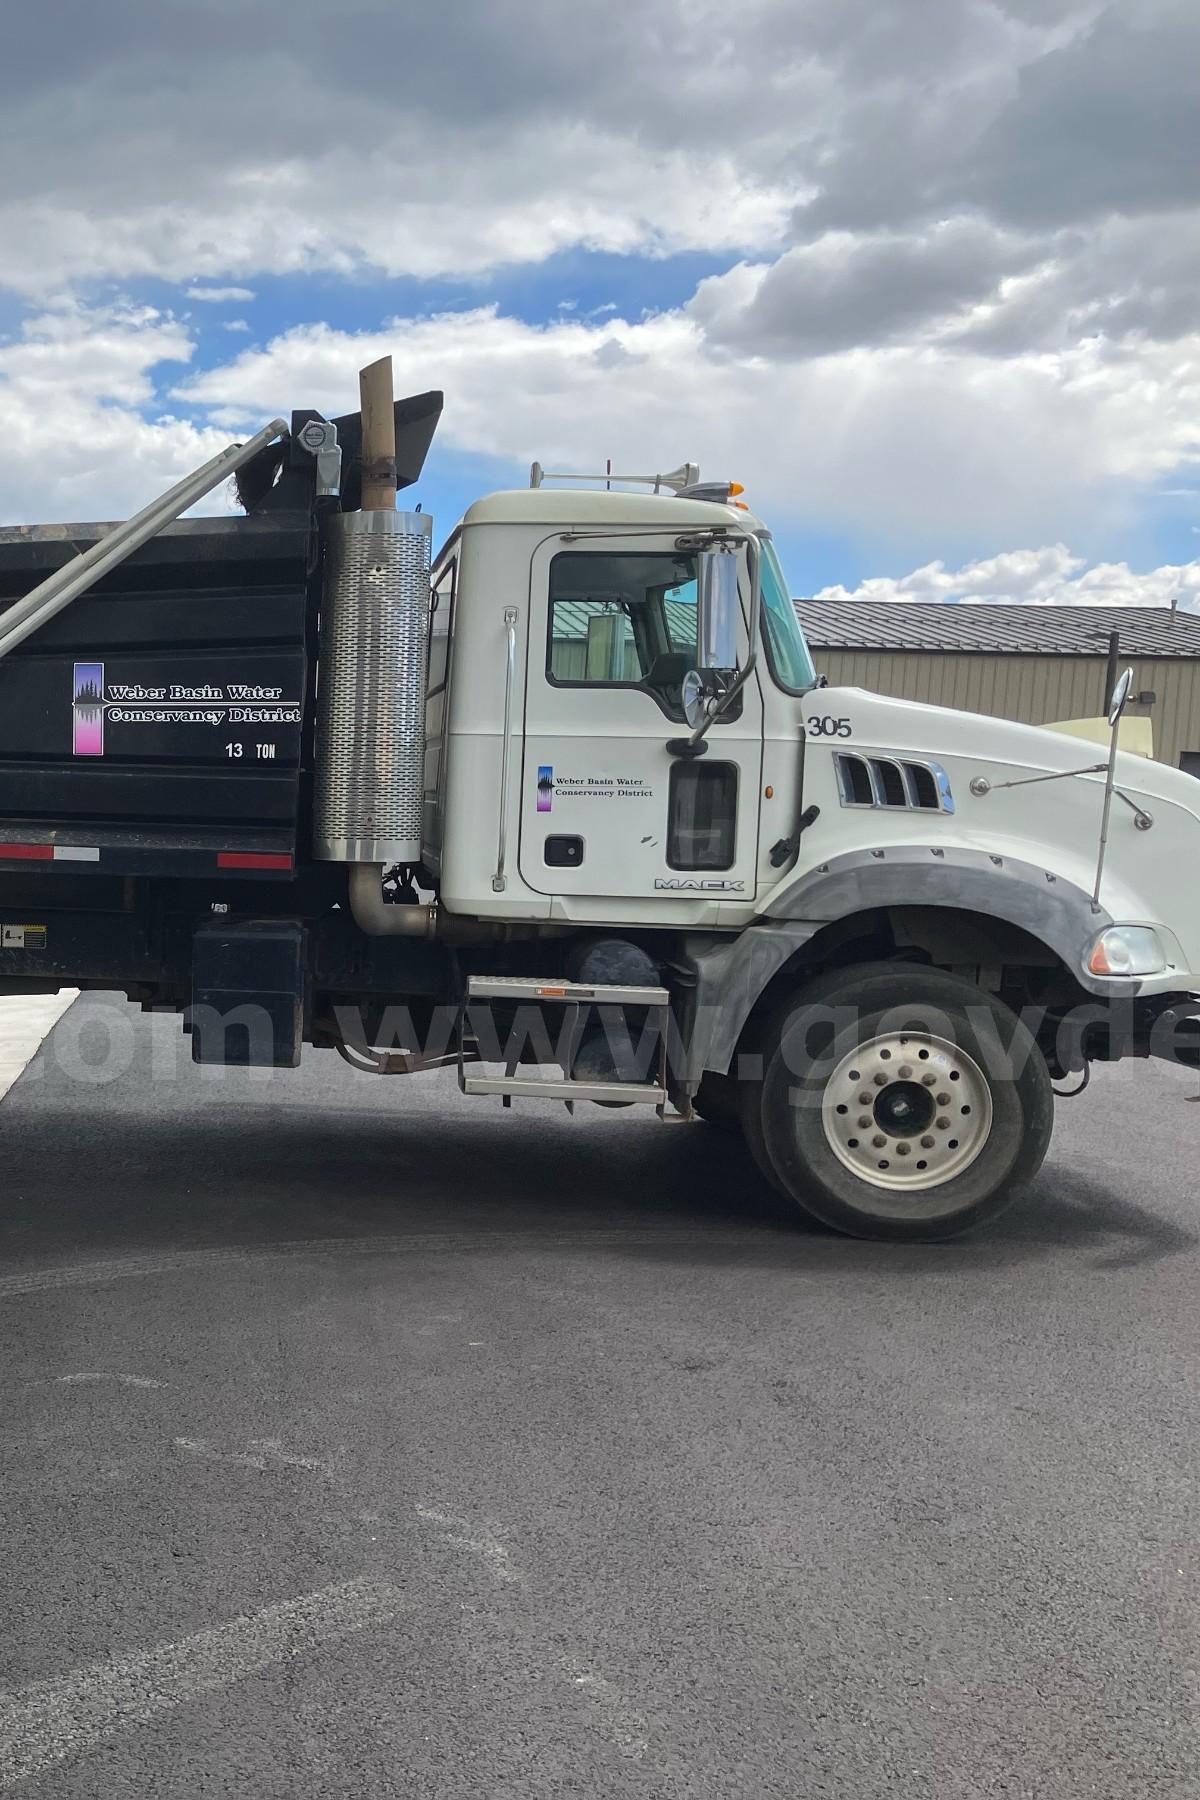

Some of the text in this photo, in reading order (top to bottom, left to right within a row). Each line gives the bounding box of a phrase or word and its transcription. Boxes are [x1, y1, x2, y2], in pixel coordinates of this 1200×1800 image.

[108, 685, 283, 700] Weber Basin Water
[107, 708, 301, 725] Conservancy District
[807, 716, 853, 738] 305
[225, 743, 275, 759] 13 TON
[556, 777, 644, 786] Weber Basin Water
[555, 788, 653, 798] Conservancy District
[654, 878, 745, 891] MACK
